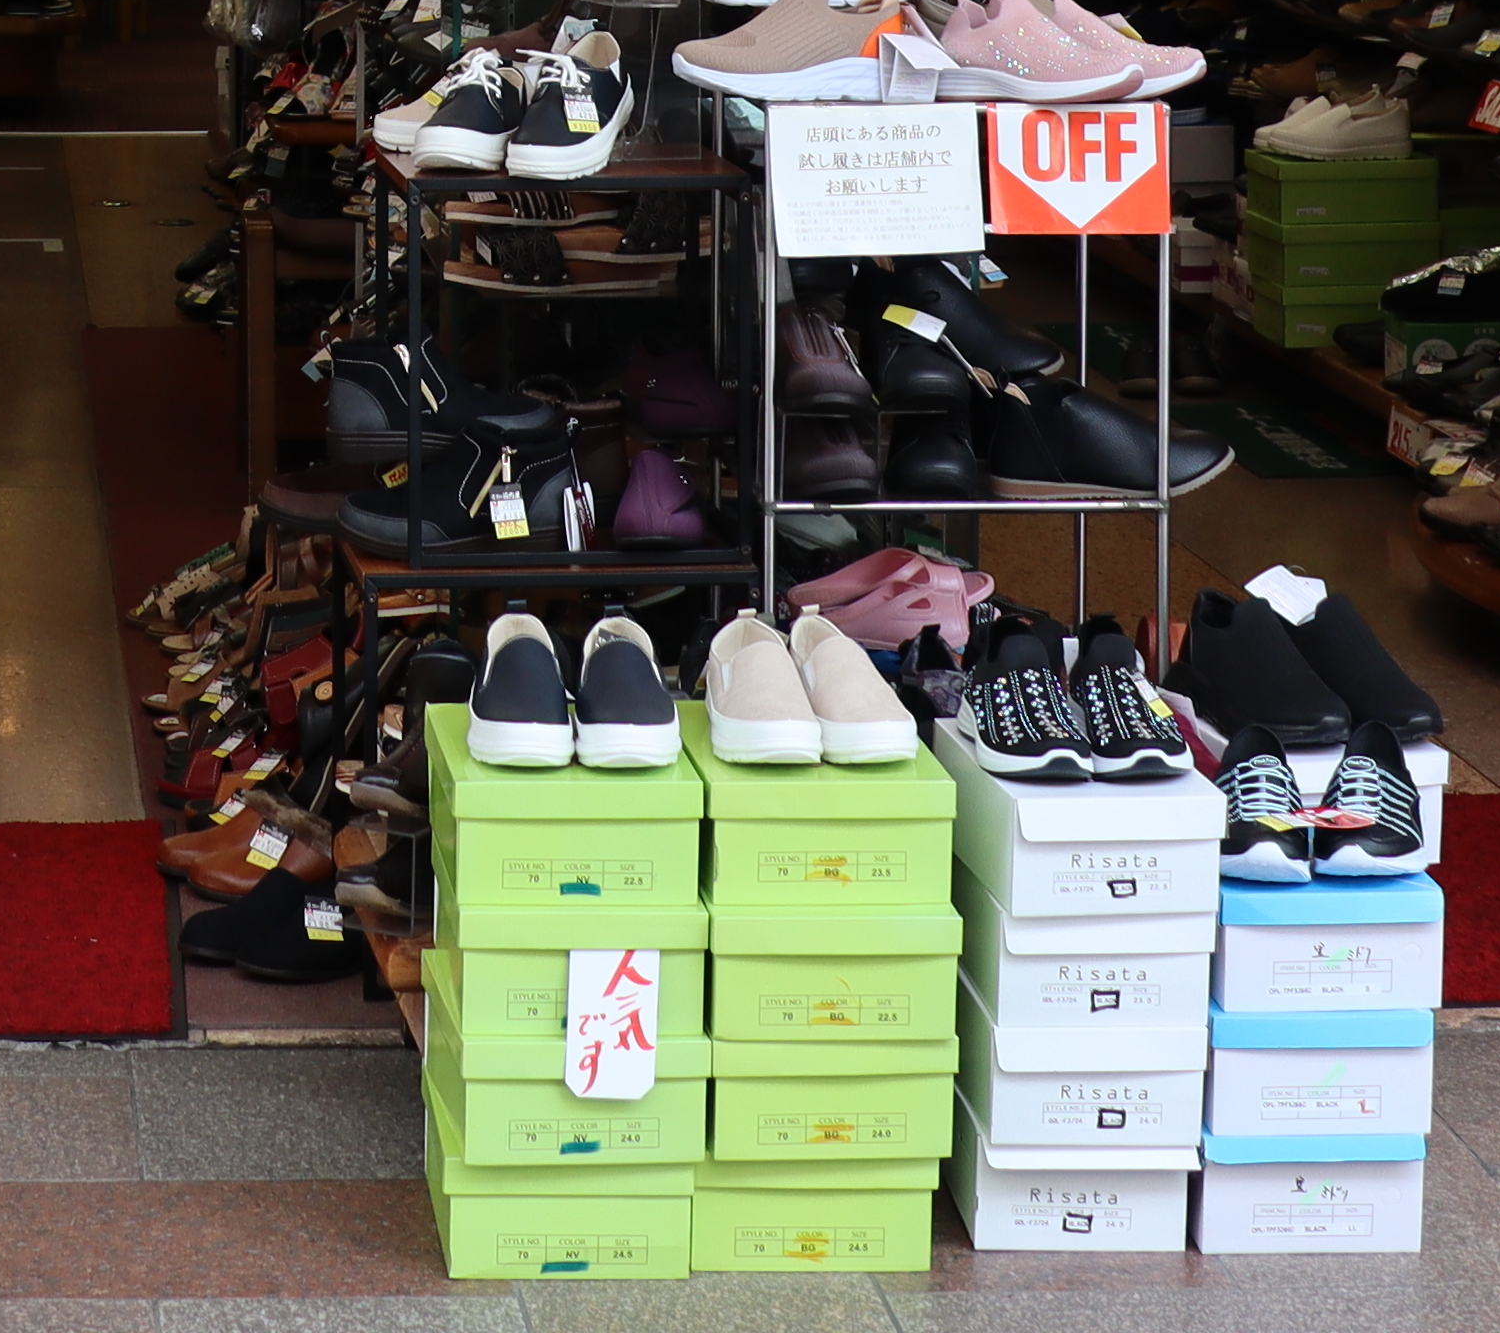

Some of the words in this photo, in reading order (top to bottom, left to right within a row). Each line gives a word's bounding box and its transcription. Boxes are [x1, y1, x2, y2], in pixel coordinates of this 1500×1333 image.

[805, 124, 941, 143] 店頭にある商品の
[1021, 110, 1139, 183] OFF
[797, 149, 952, 169] 試し履きは店舗内で
[825, 175, 928, 194] お願いします
[1070, 852, 1159, 869] Risata
[528, 874, 540, 883] 70
[576, 875, 591, 885] NV
[623, 876, 644, 886] 22.5
[777, 867, 789, 876] 70
[871, 868, 892, 877] 23.5
[1058, 965, 1148, 982] Risata
[526, 1007, 538, 1016] 70
[782, 1012, 794, 1021] 70
[877, 1013, 898, 1022] 22.5
[578, 1013, 607, 1096] です
[1060, 1084, 1150, 1101] Risata
[525, 1133, 537, 1142] 70
[573, 1133, 588, 1143] NV
[620, 1134, 641, 1143] 24.0
[776, 1132, 789, 1141] 70
[871, 1129, 891, 1138] 24.0
[1029, 1186, 1119, 1204] Risata
[517, 1250, 529, 1259] 70
[565, 1250, 580, 1259] NV
[612, 1250, 633, 1259] 24.5
[753, 1244, 765, 1253] 70
[801, 1243, 816, 1252] BG
[848, 1243, 869, 1252] 24.5
